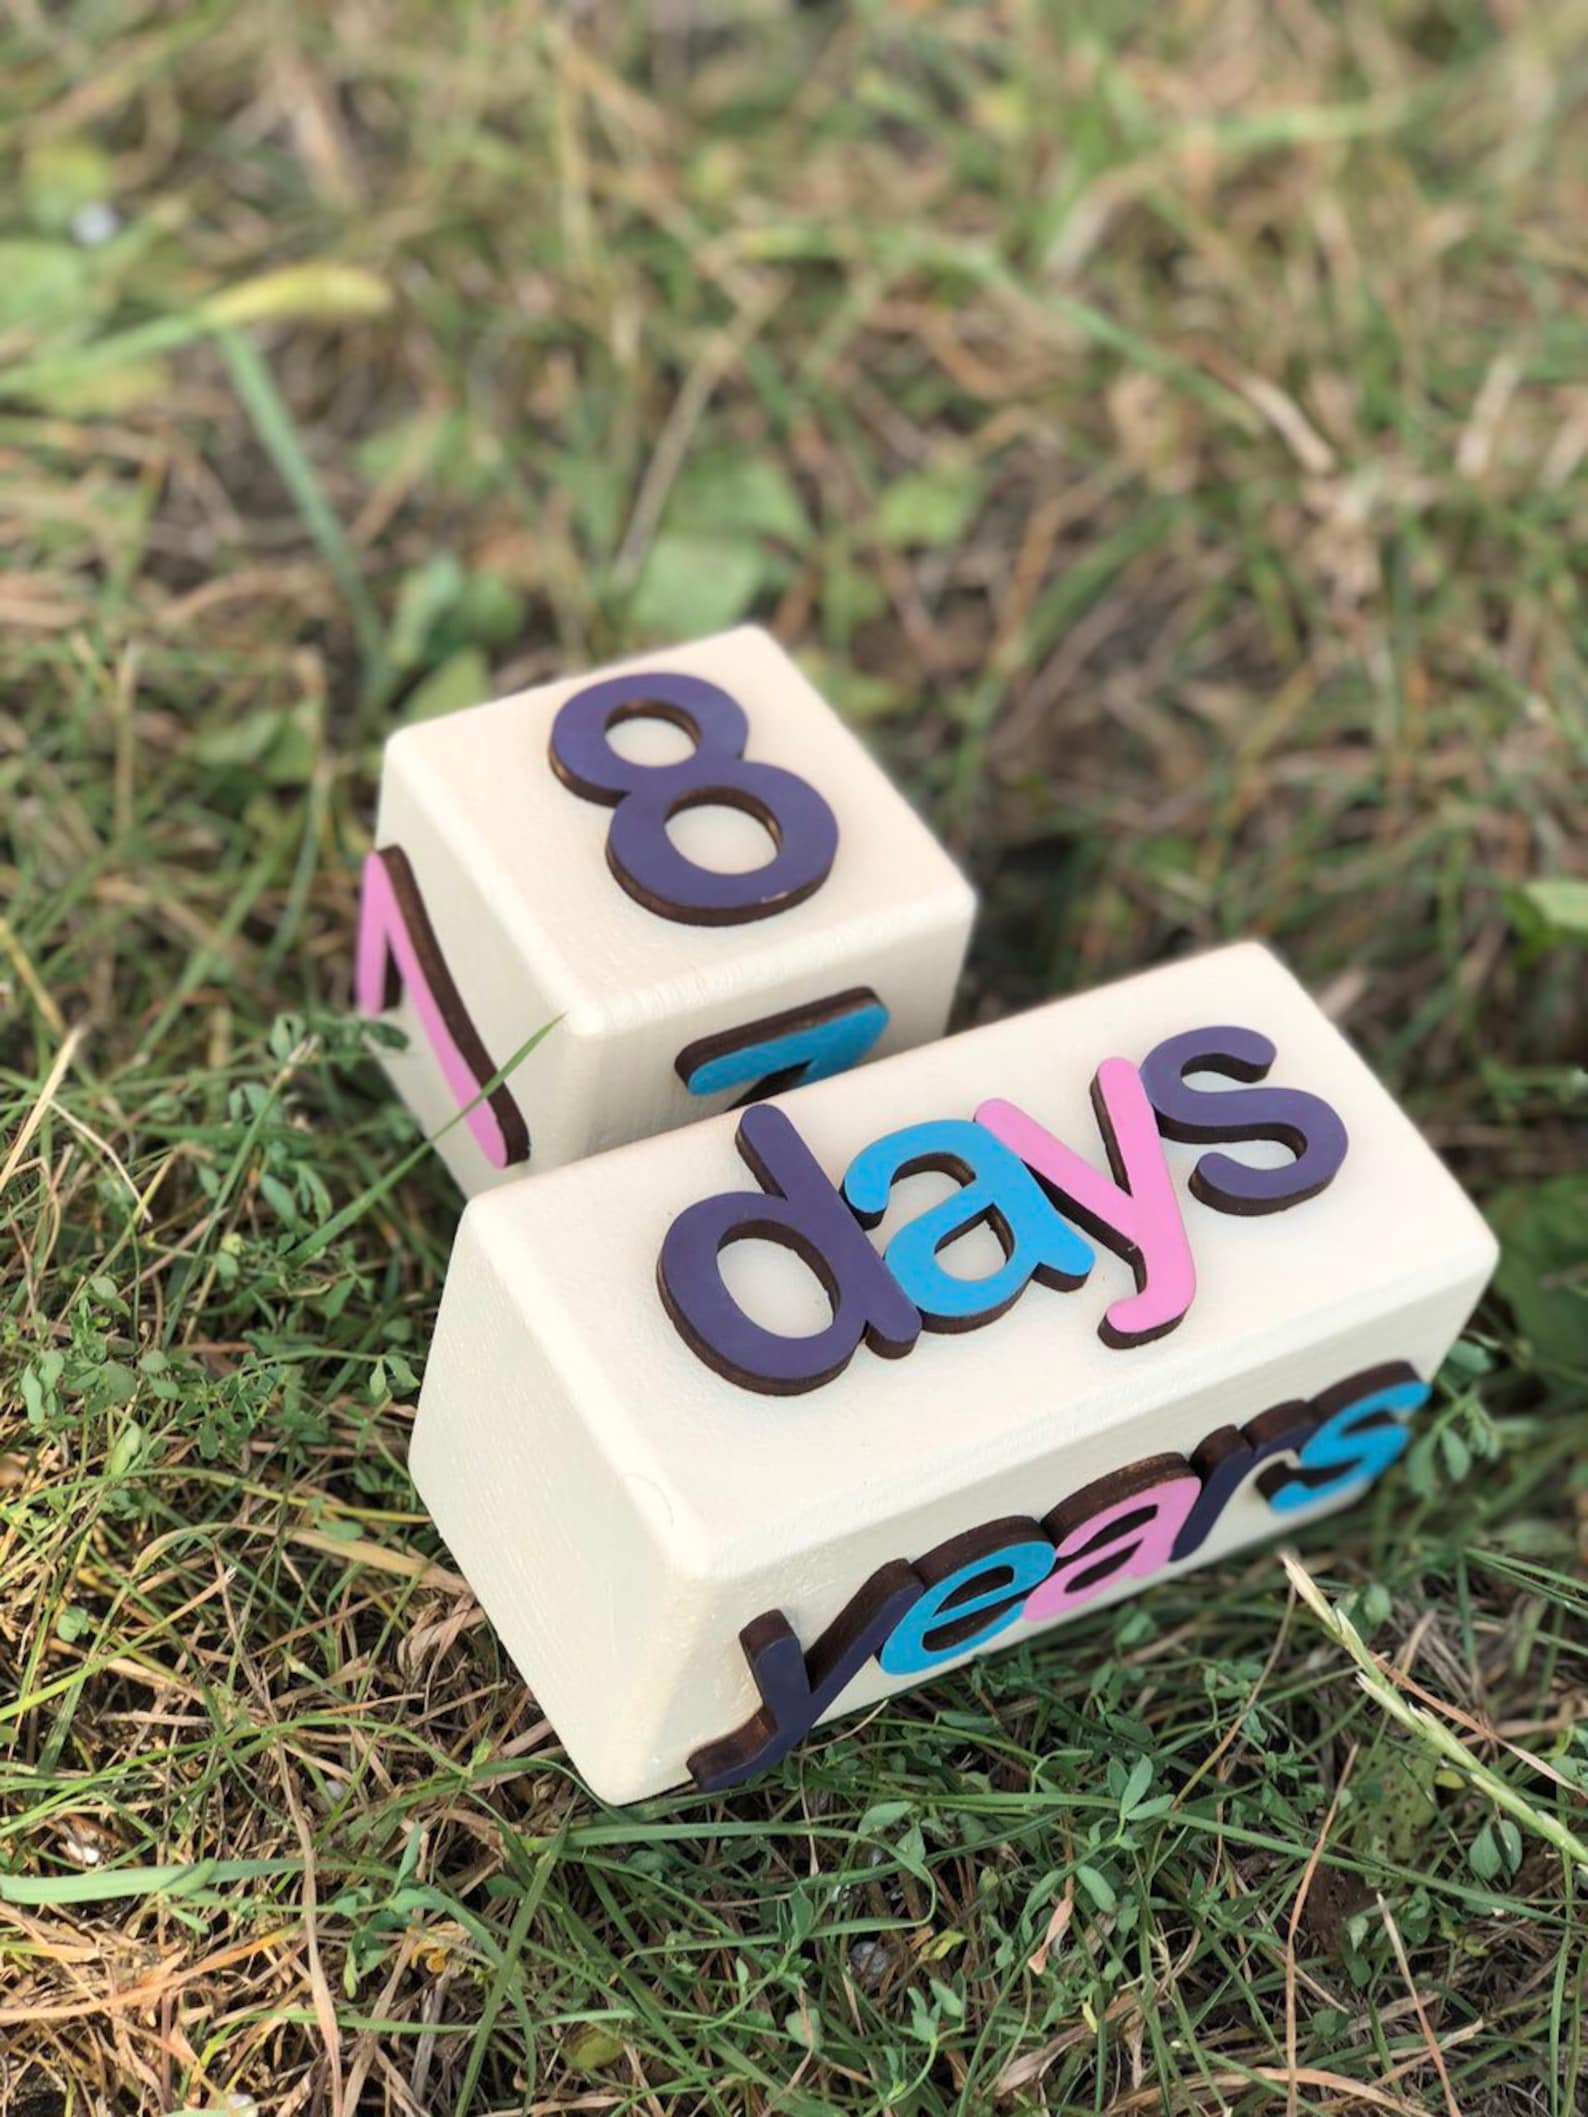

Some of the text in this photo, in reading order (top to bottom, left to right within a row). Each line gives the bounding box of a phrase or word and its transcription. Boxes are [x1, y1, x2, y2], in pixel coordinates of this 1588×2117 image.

[549, 671, 839, 927] 8
[656, 1025, 1349, 1396] days
[686, 1360, 1432, 1792] years
